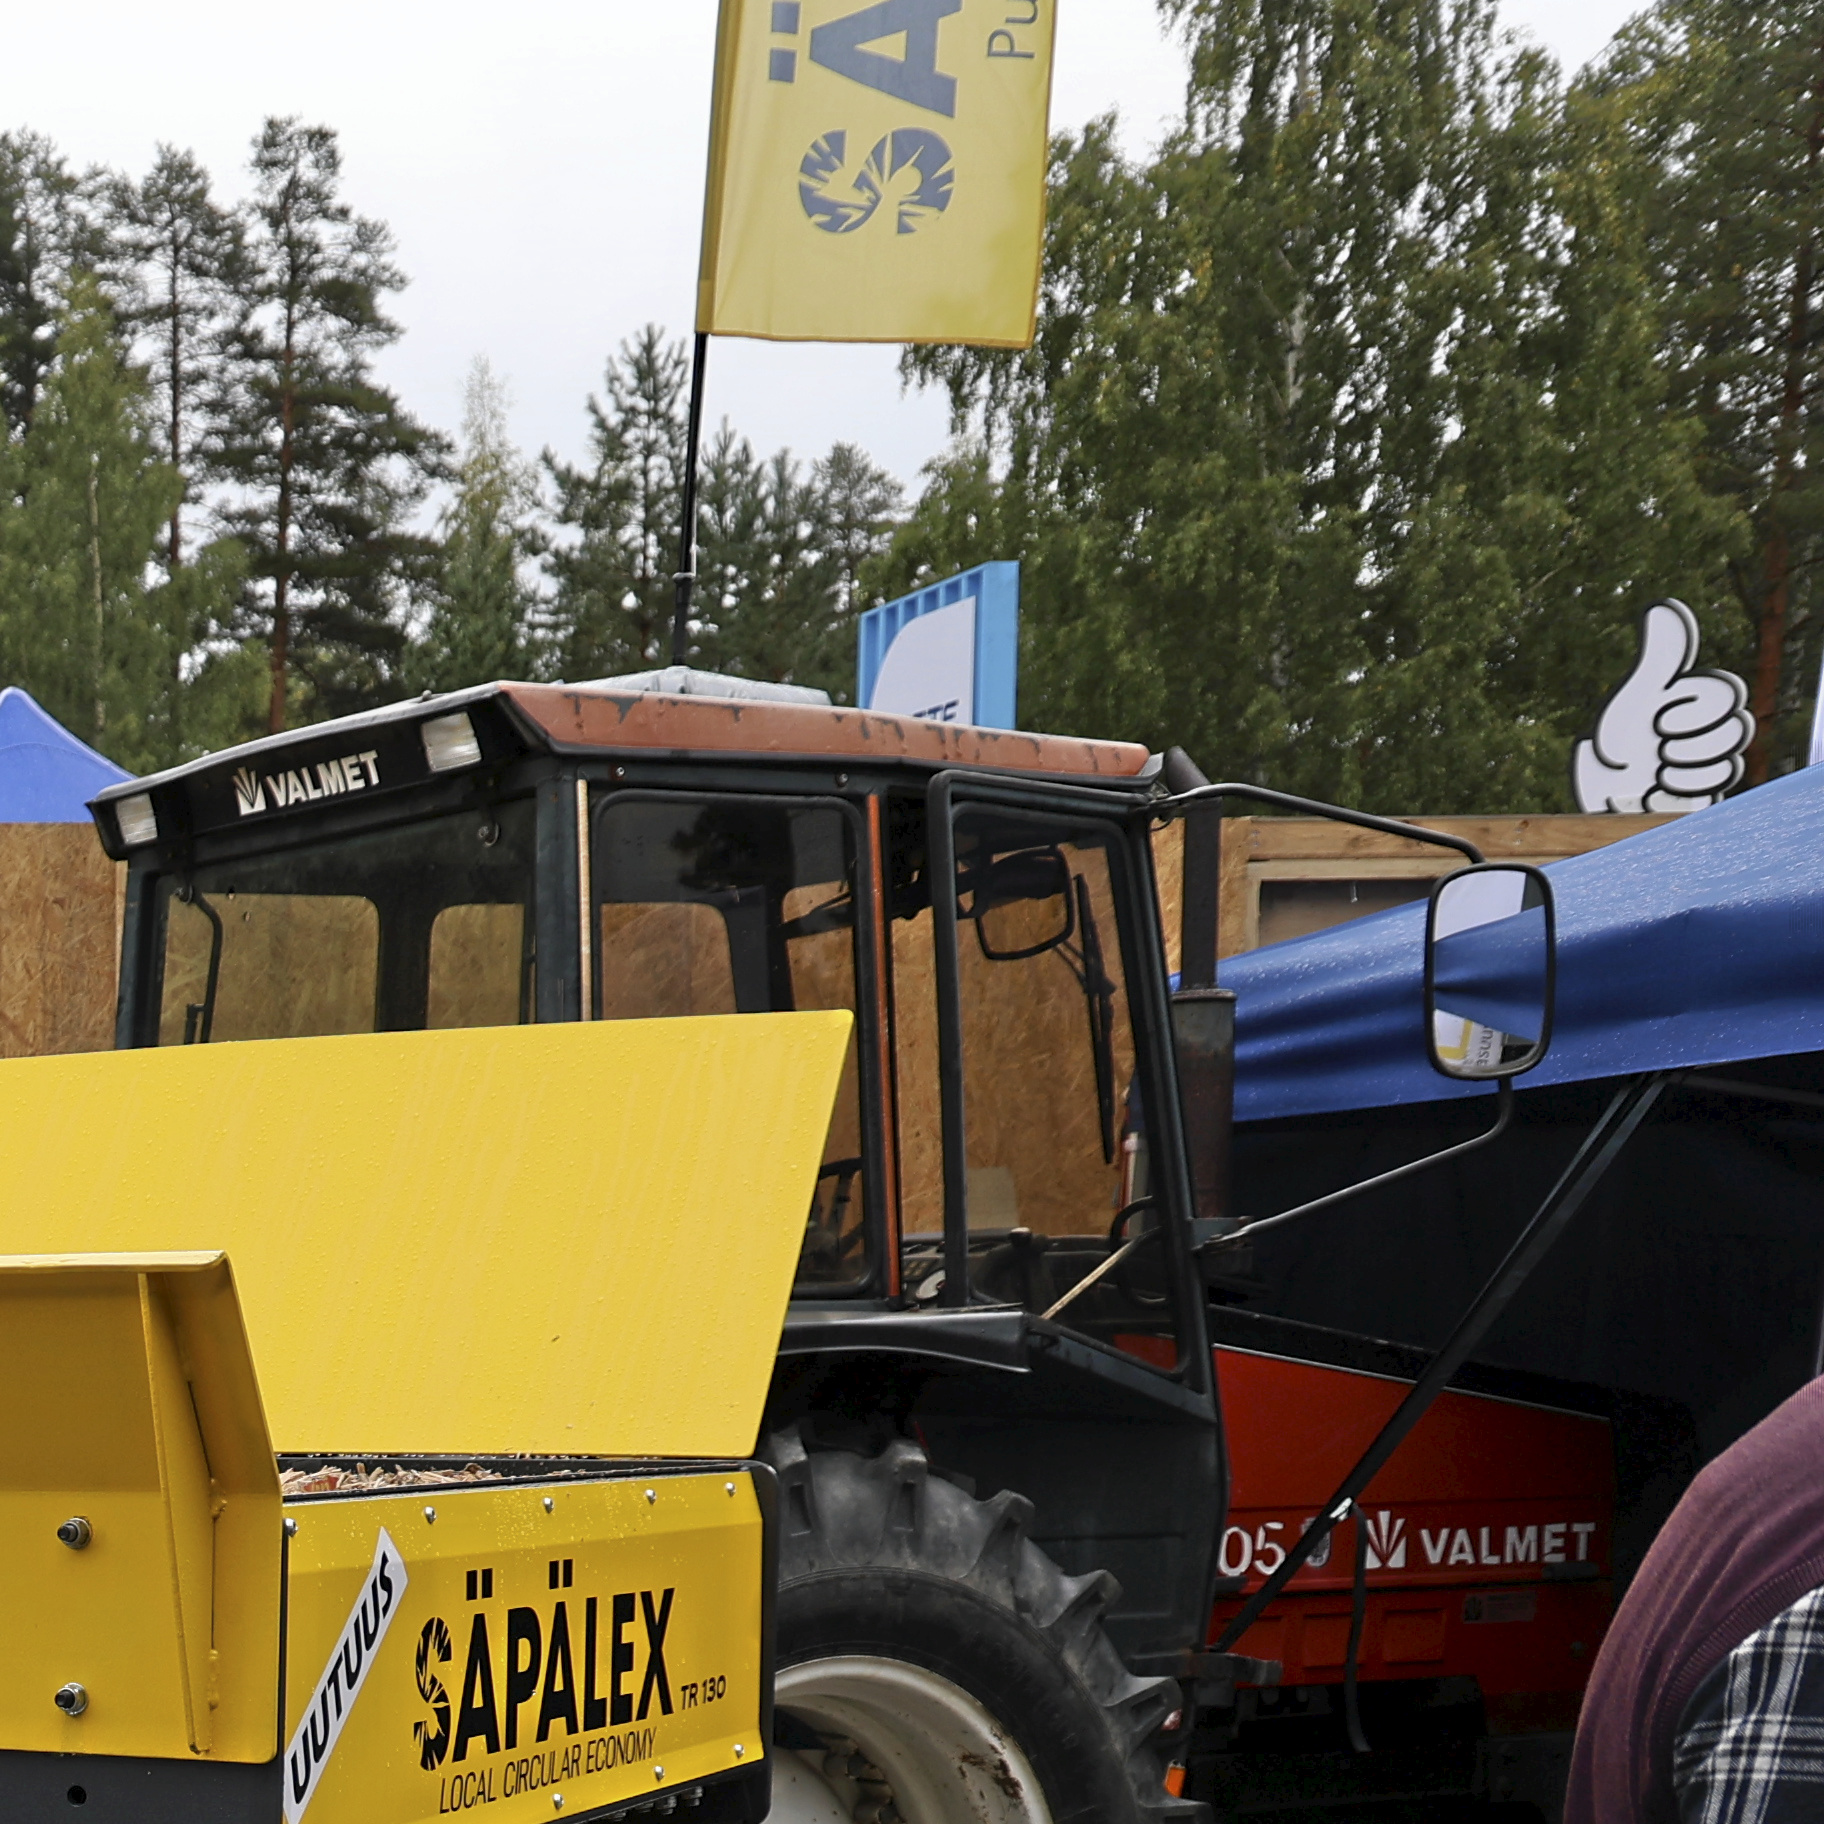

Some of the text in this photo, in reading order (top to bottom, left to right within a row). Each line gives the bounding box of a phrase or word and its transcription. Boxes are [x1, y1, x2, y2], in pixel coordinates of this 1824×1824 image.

[266, 749, 380, 808] VALMET
[1420, 1522, 1596, 1566] VALMET
[291, 1551, 394, 1804] UUTUUS
[414, 1559, 676, 1771] SÄPÄLEX
[680, 1675, 727, 1710] TR 130
[440, 1726, 658, 1814] LOCAL CIRCULAR ECONOMY
